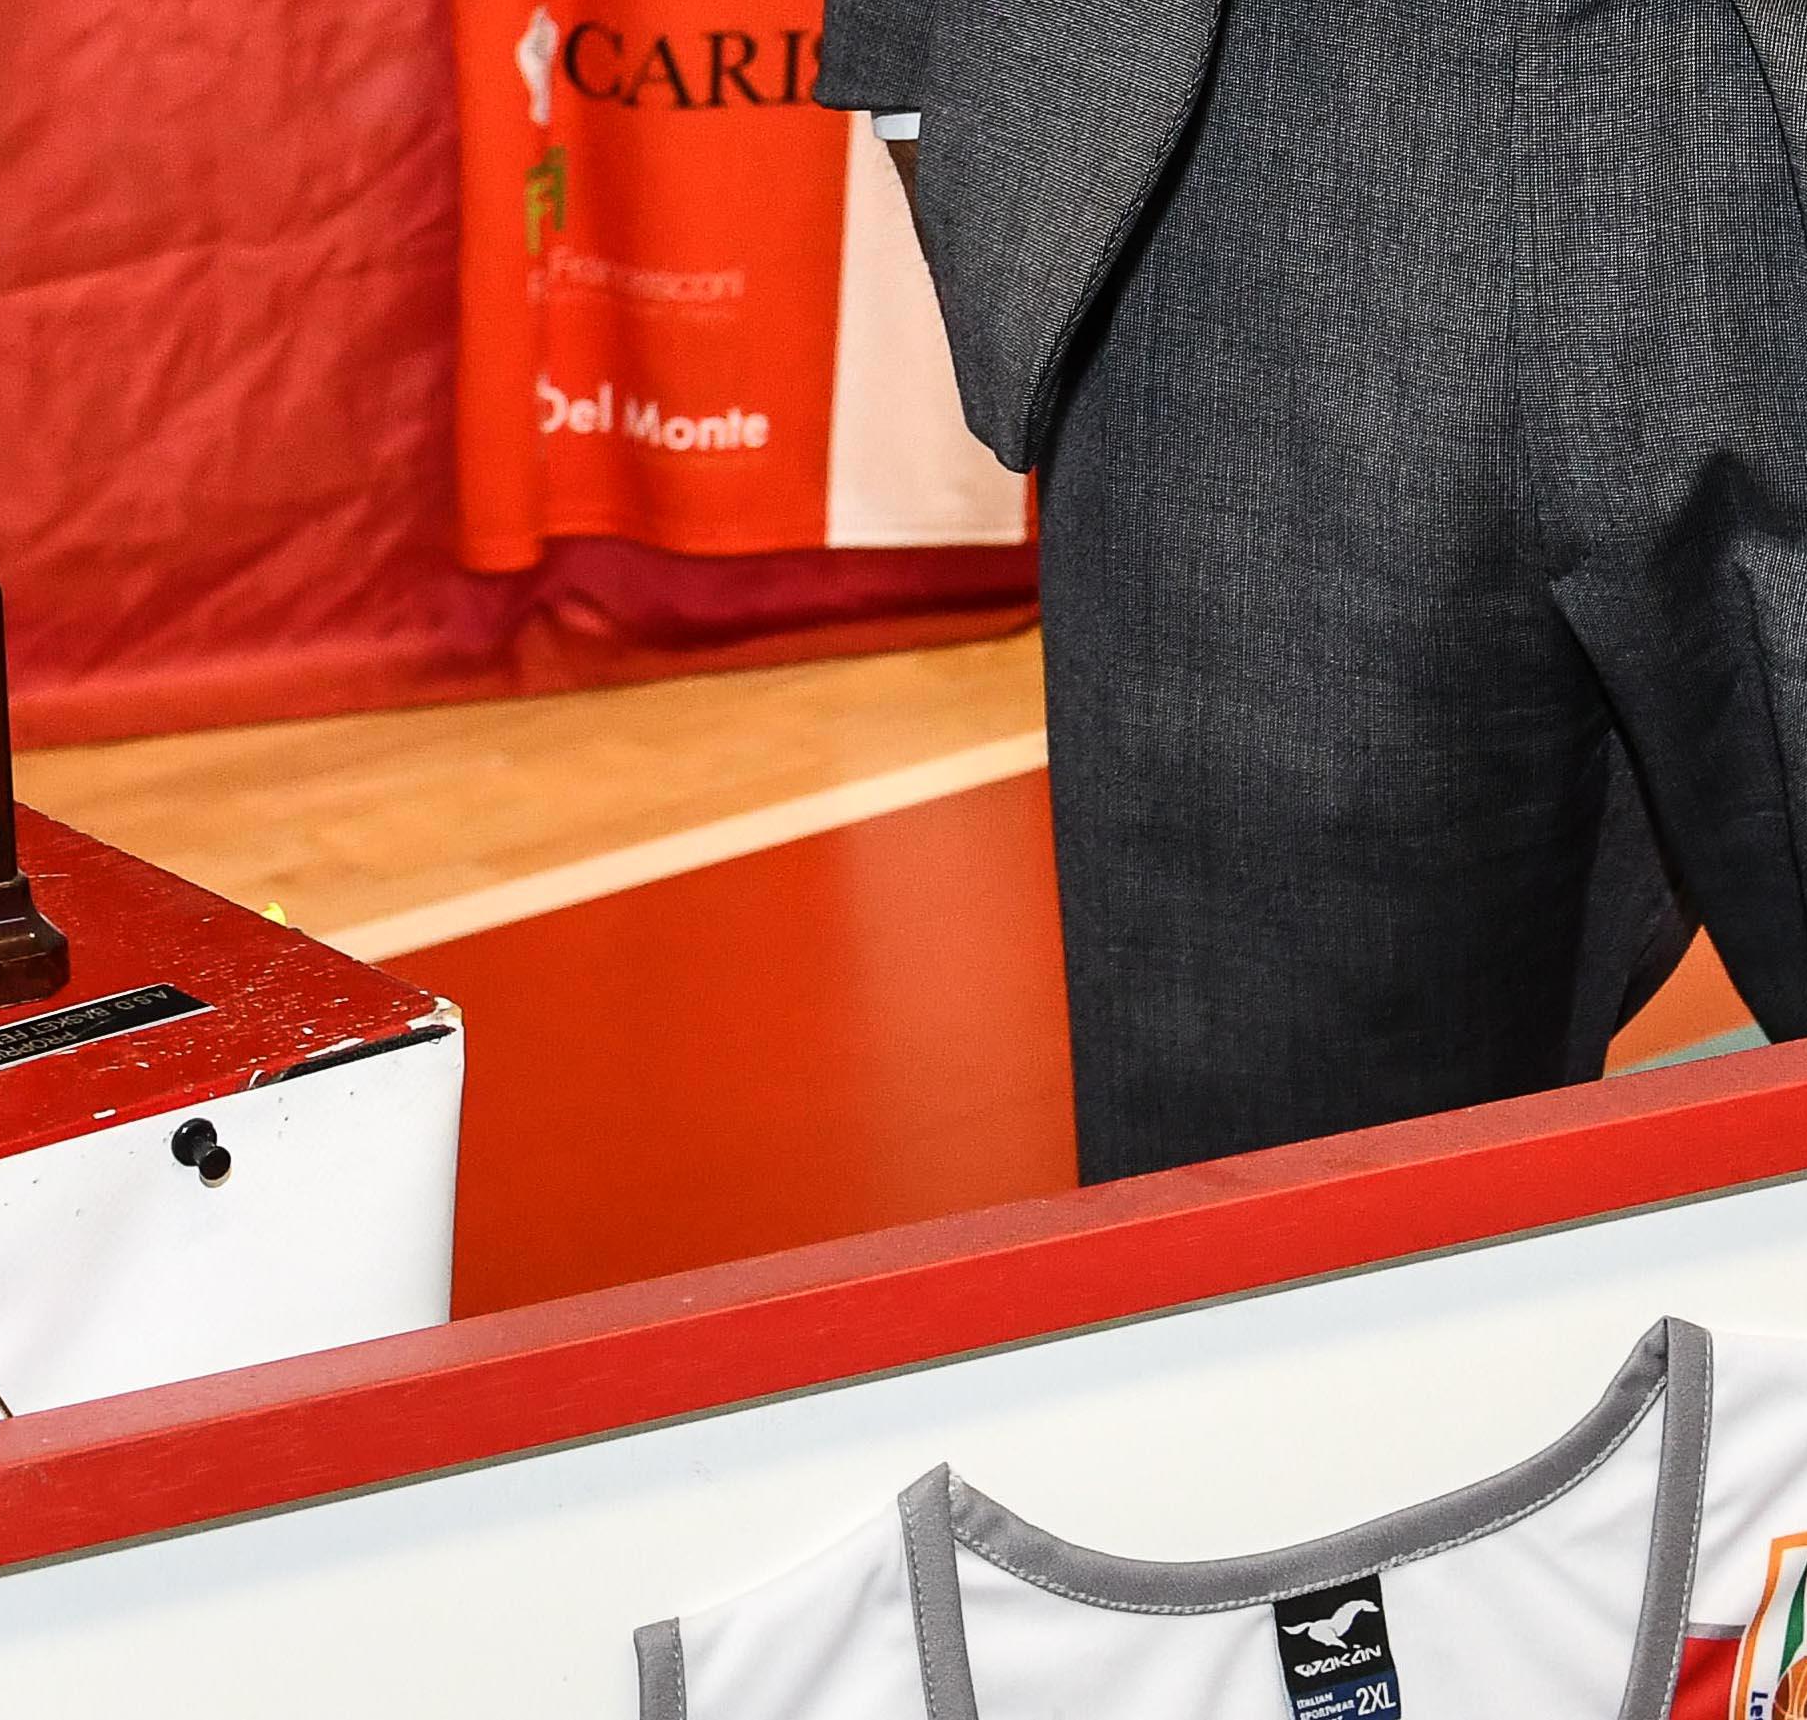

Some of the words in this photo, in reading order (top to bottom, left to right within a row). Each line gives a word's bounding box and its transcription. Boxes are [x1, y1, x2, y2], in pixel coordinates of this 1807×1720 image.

[563, 19, 825, 109] CARI
[623, 397, 770, 452] Monte
[29, 1003, 106, 1035] BASKET
[1296, 1691, 1334, 1710] ITALIAN
[1355, 1681, 1397, 1717] 2XL
